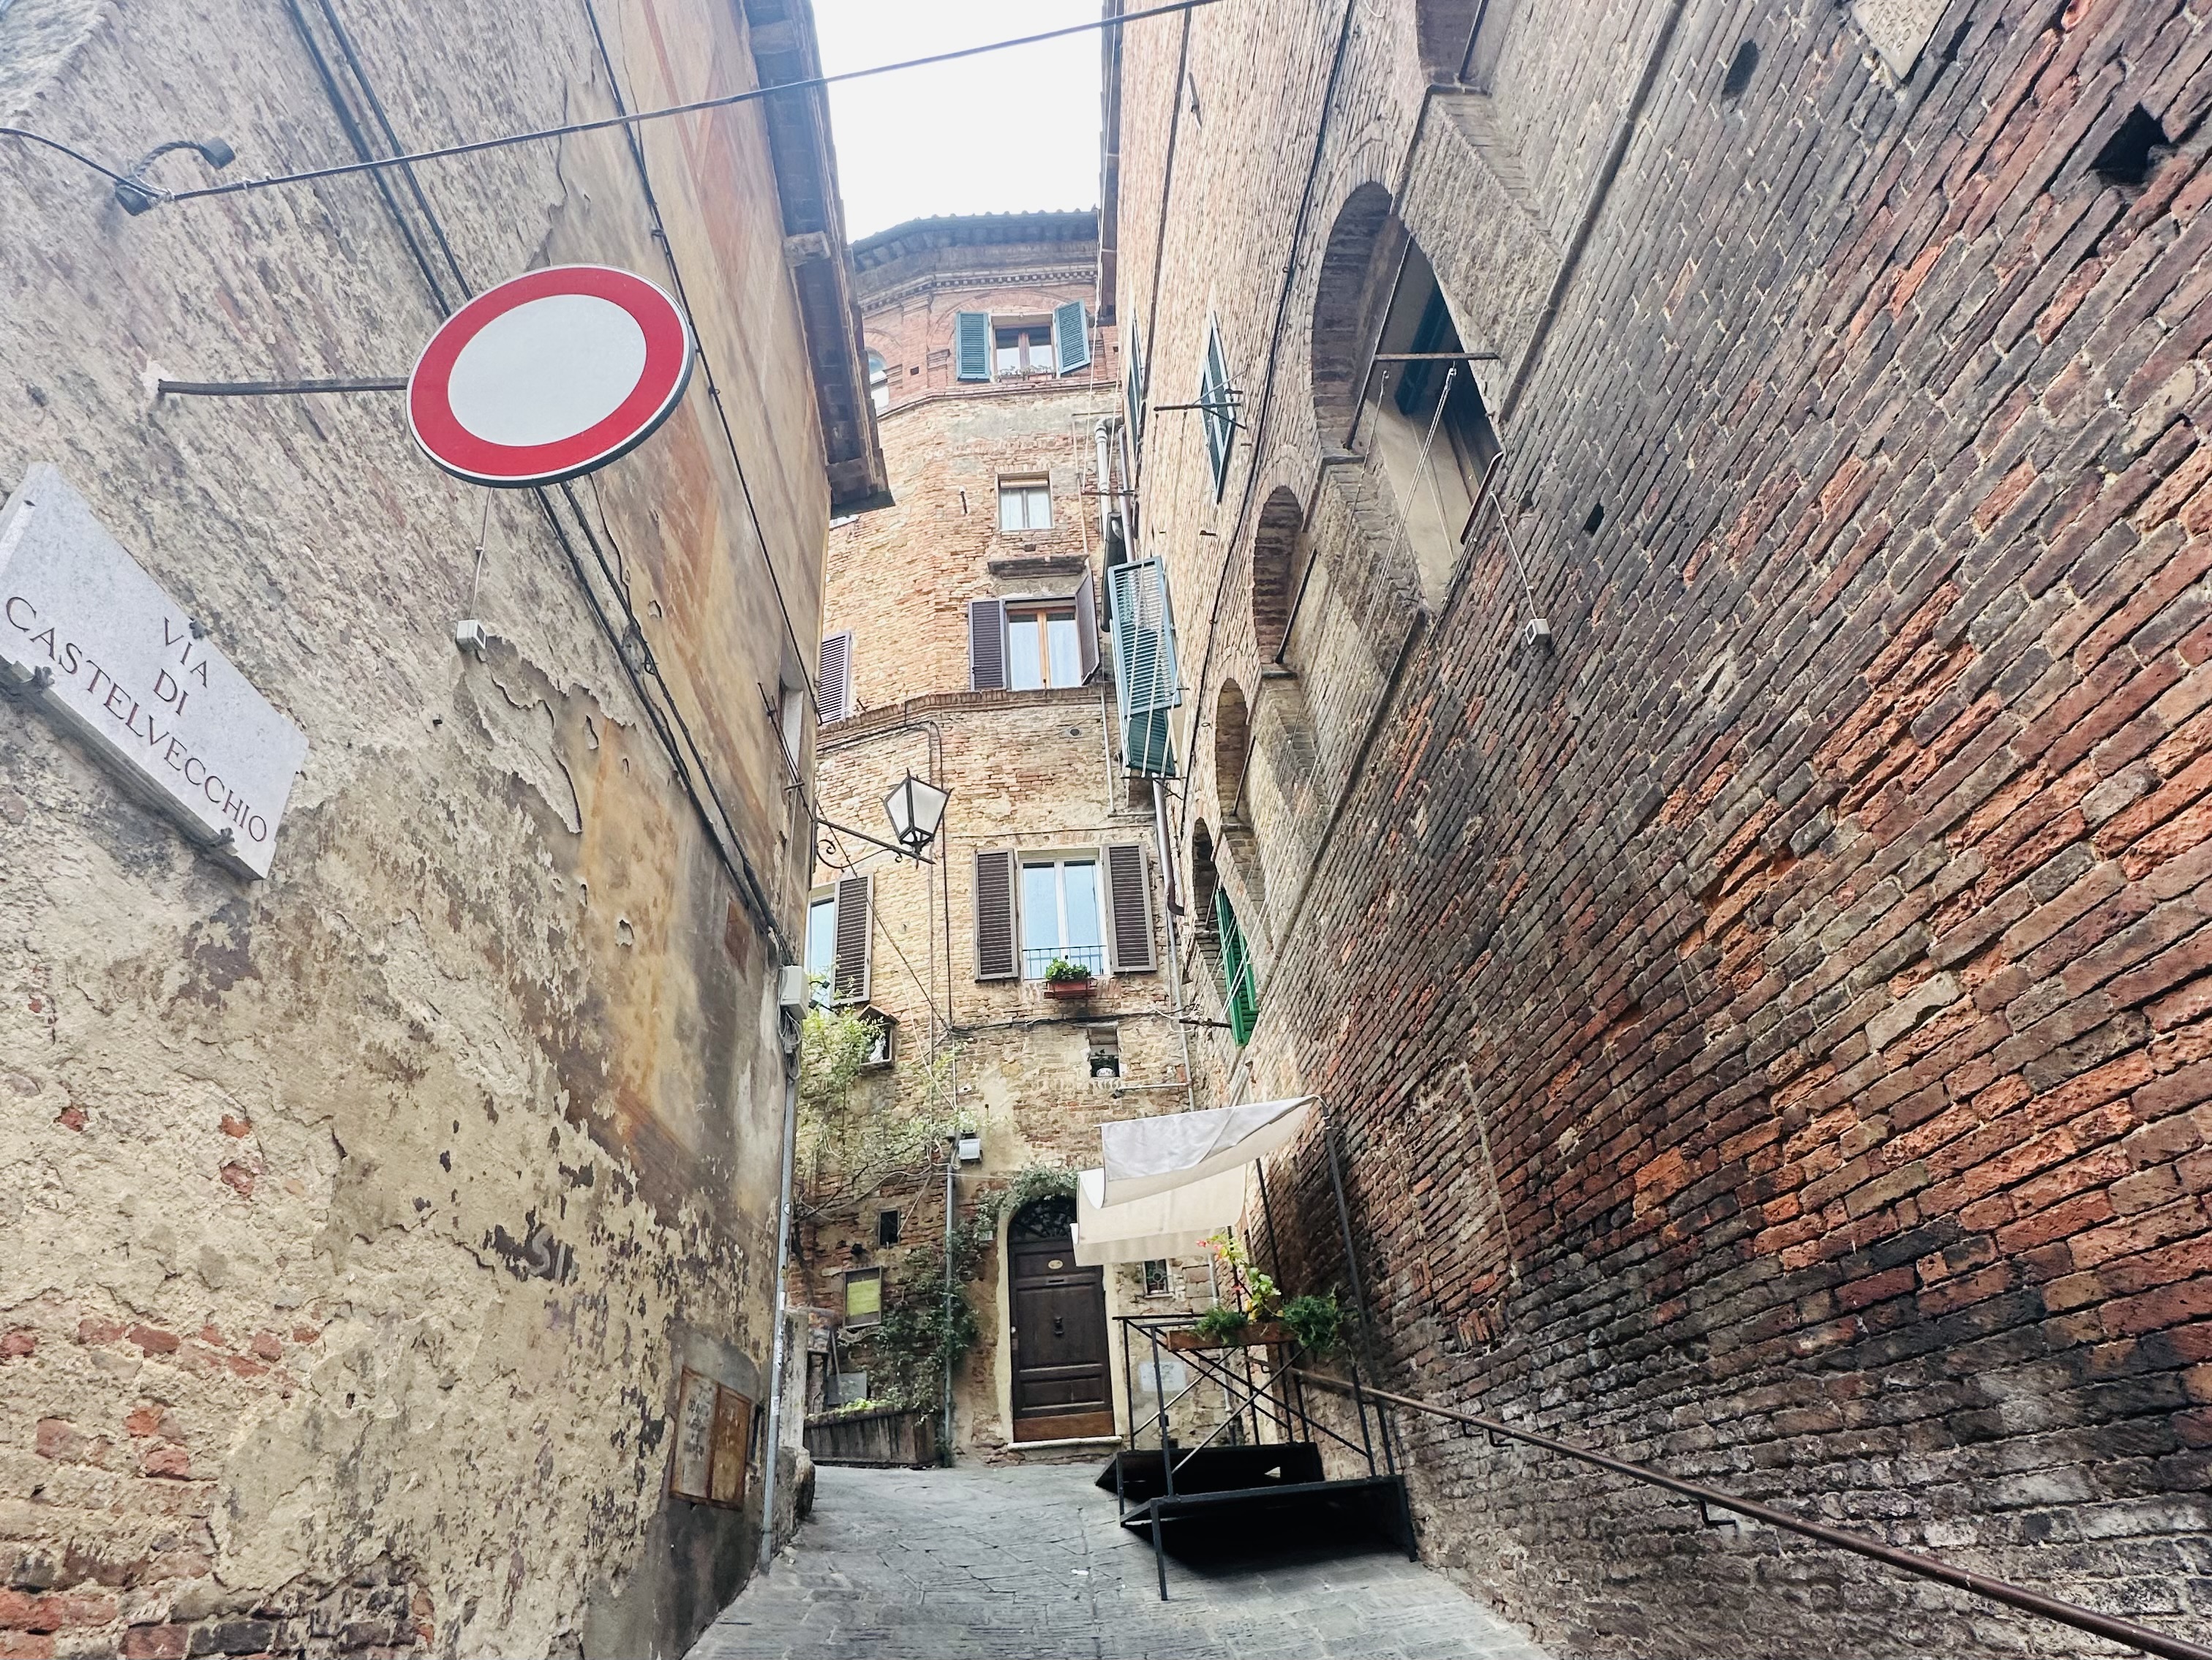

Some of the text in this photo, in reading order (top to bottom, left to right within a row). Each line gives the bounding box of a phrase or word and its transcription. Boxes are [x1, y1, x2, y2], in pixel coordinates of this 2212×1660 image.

[165, 616, 207, 688] VIA
[6, 596, 267, 842] CASTELVECCHIO
[153, 667, 189, 716] DI
